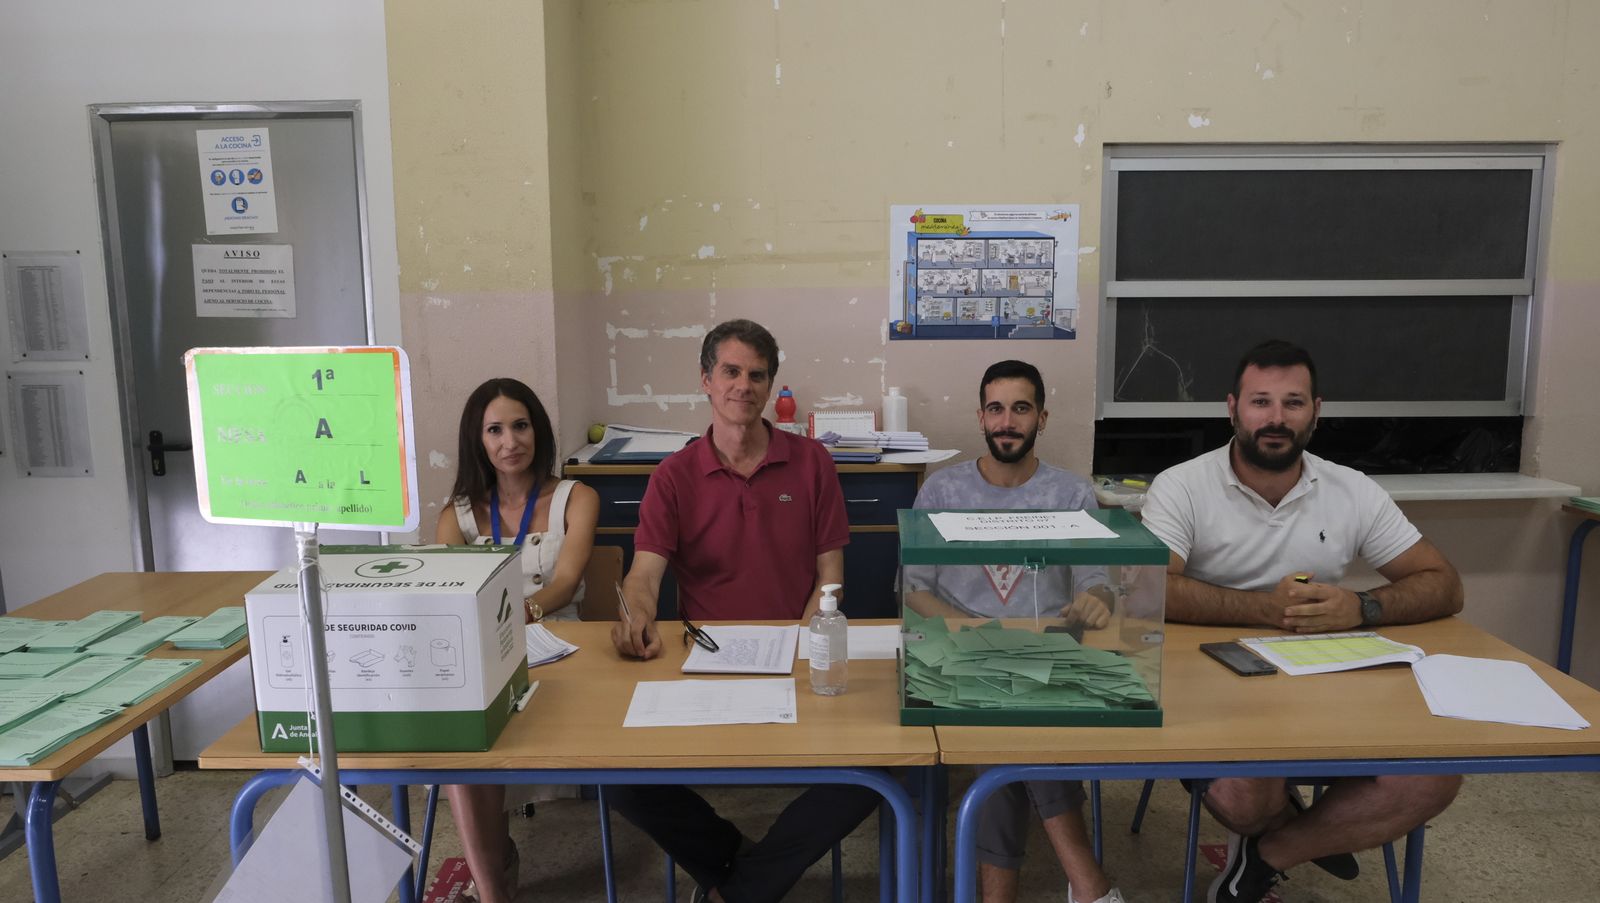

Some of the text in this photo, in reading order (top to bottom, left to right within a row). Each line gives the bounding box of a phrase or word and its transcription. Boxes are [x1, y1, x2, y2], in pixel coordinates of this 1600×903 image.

[315, 418, 333, 439] A
[295, 470, 307, 484] A
[360, 470, 371, 485] L
[337, 624, 388, 632] SEGURIDAD
